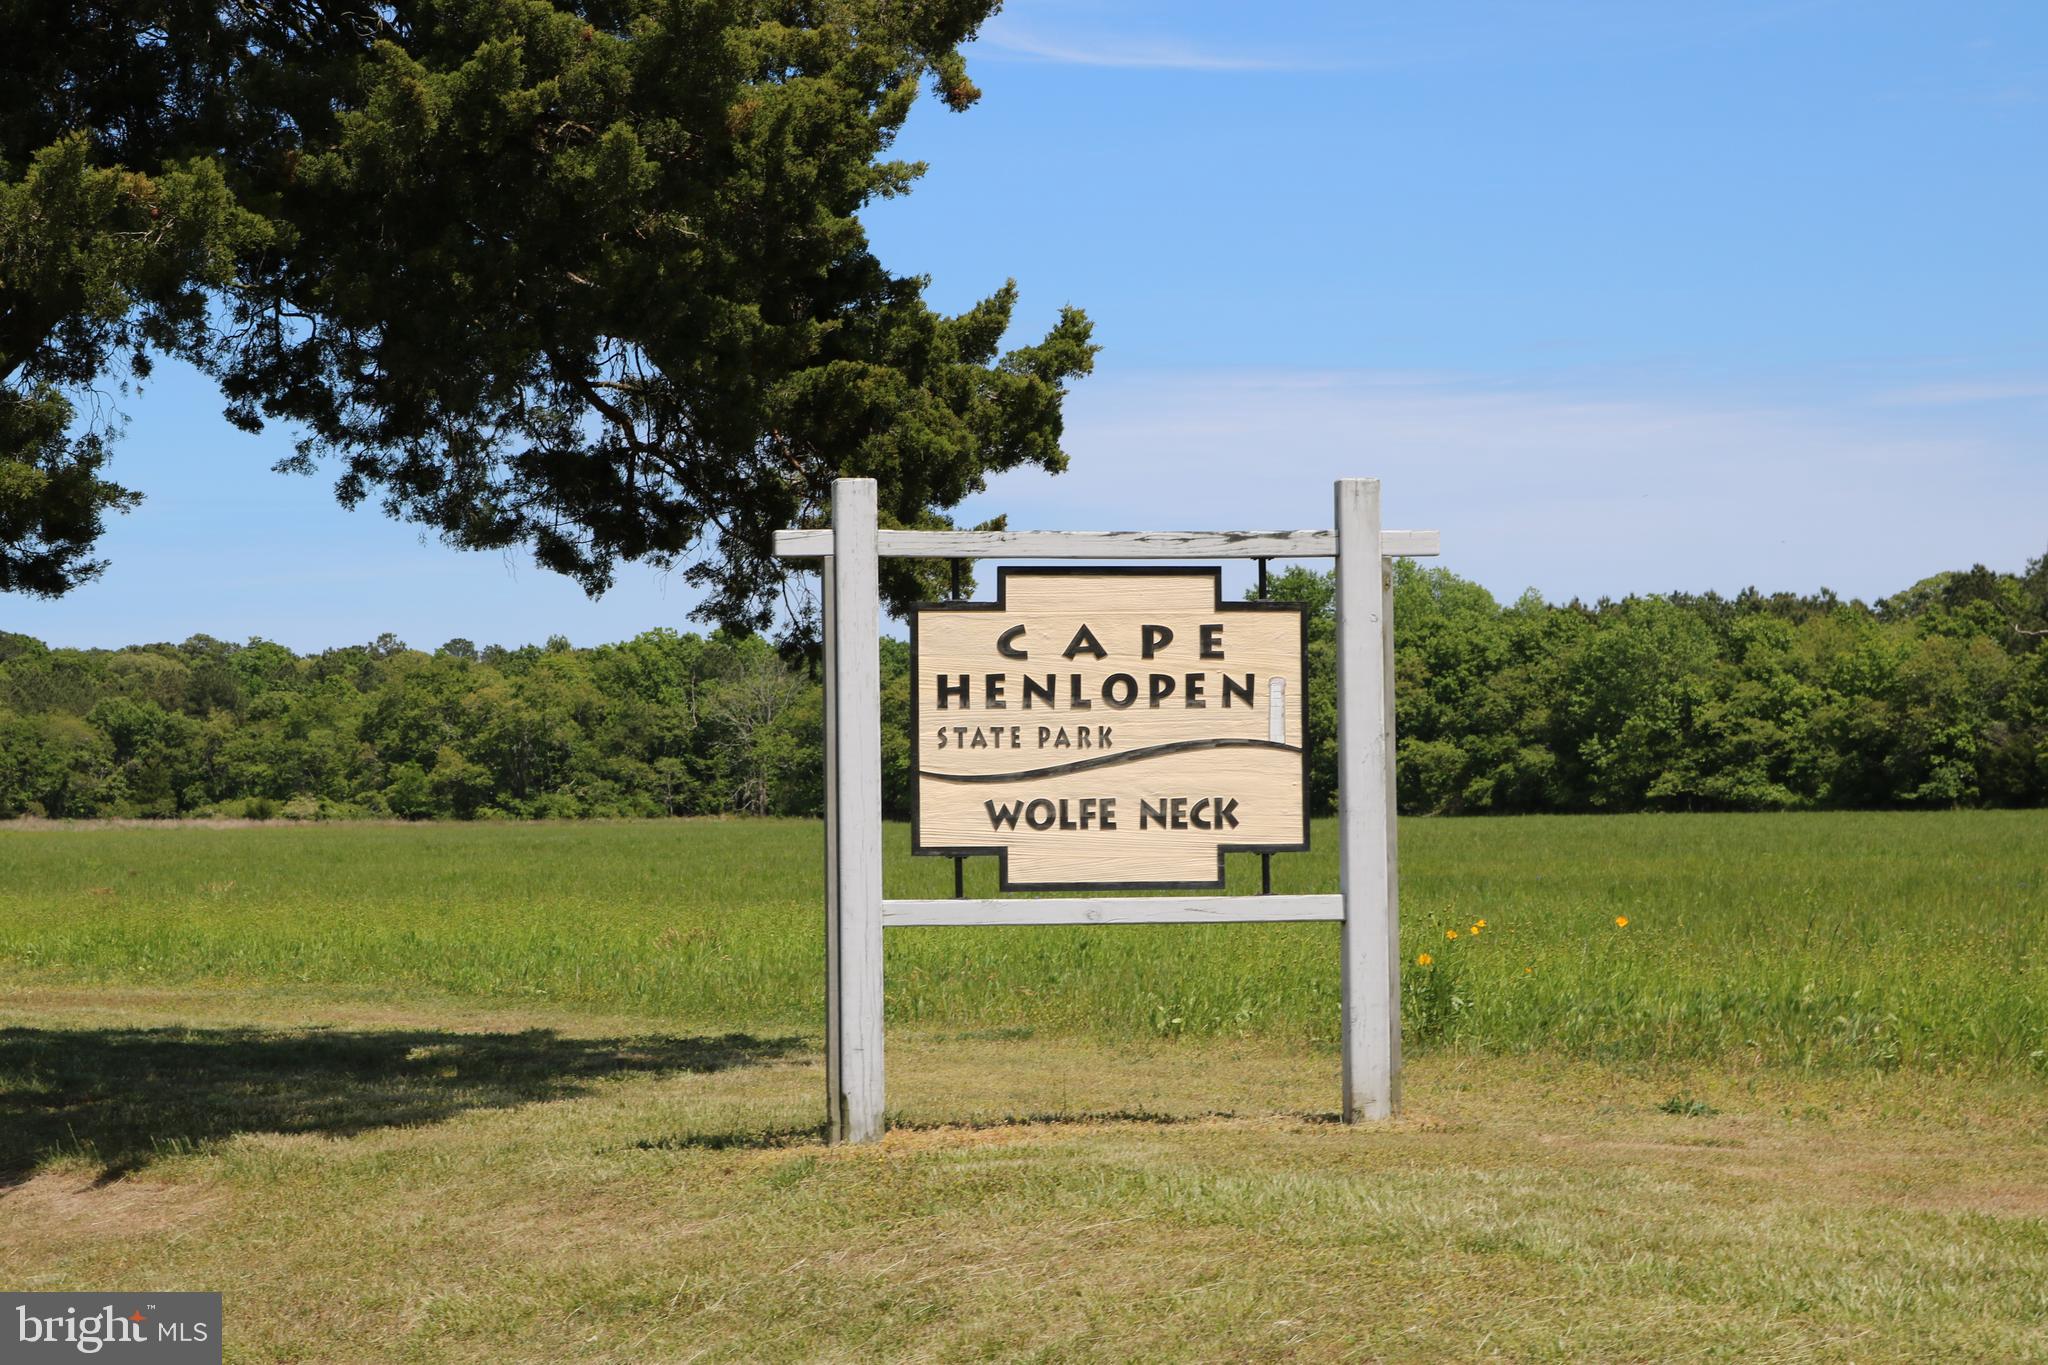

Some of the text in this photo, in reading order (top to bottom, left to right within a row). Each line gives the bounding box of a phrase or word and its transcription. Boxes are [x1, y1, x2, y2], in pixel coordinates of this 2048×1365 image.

[996, 623, 1225, 661] CAPE
[936, 672, 1255, 710] HENLOPEN
[937, 725, 1113, 749] STATE PARK
[984, 797, 1240, 831] WOLFE NECK
